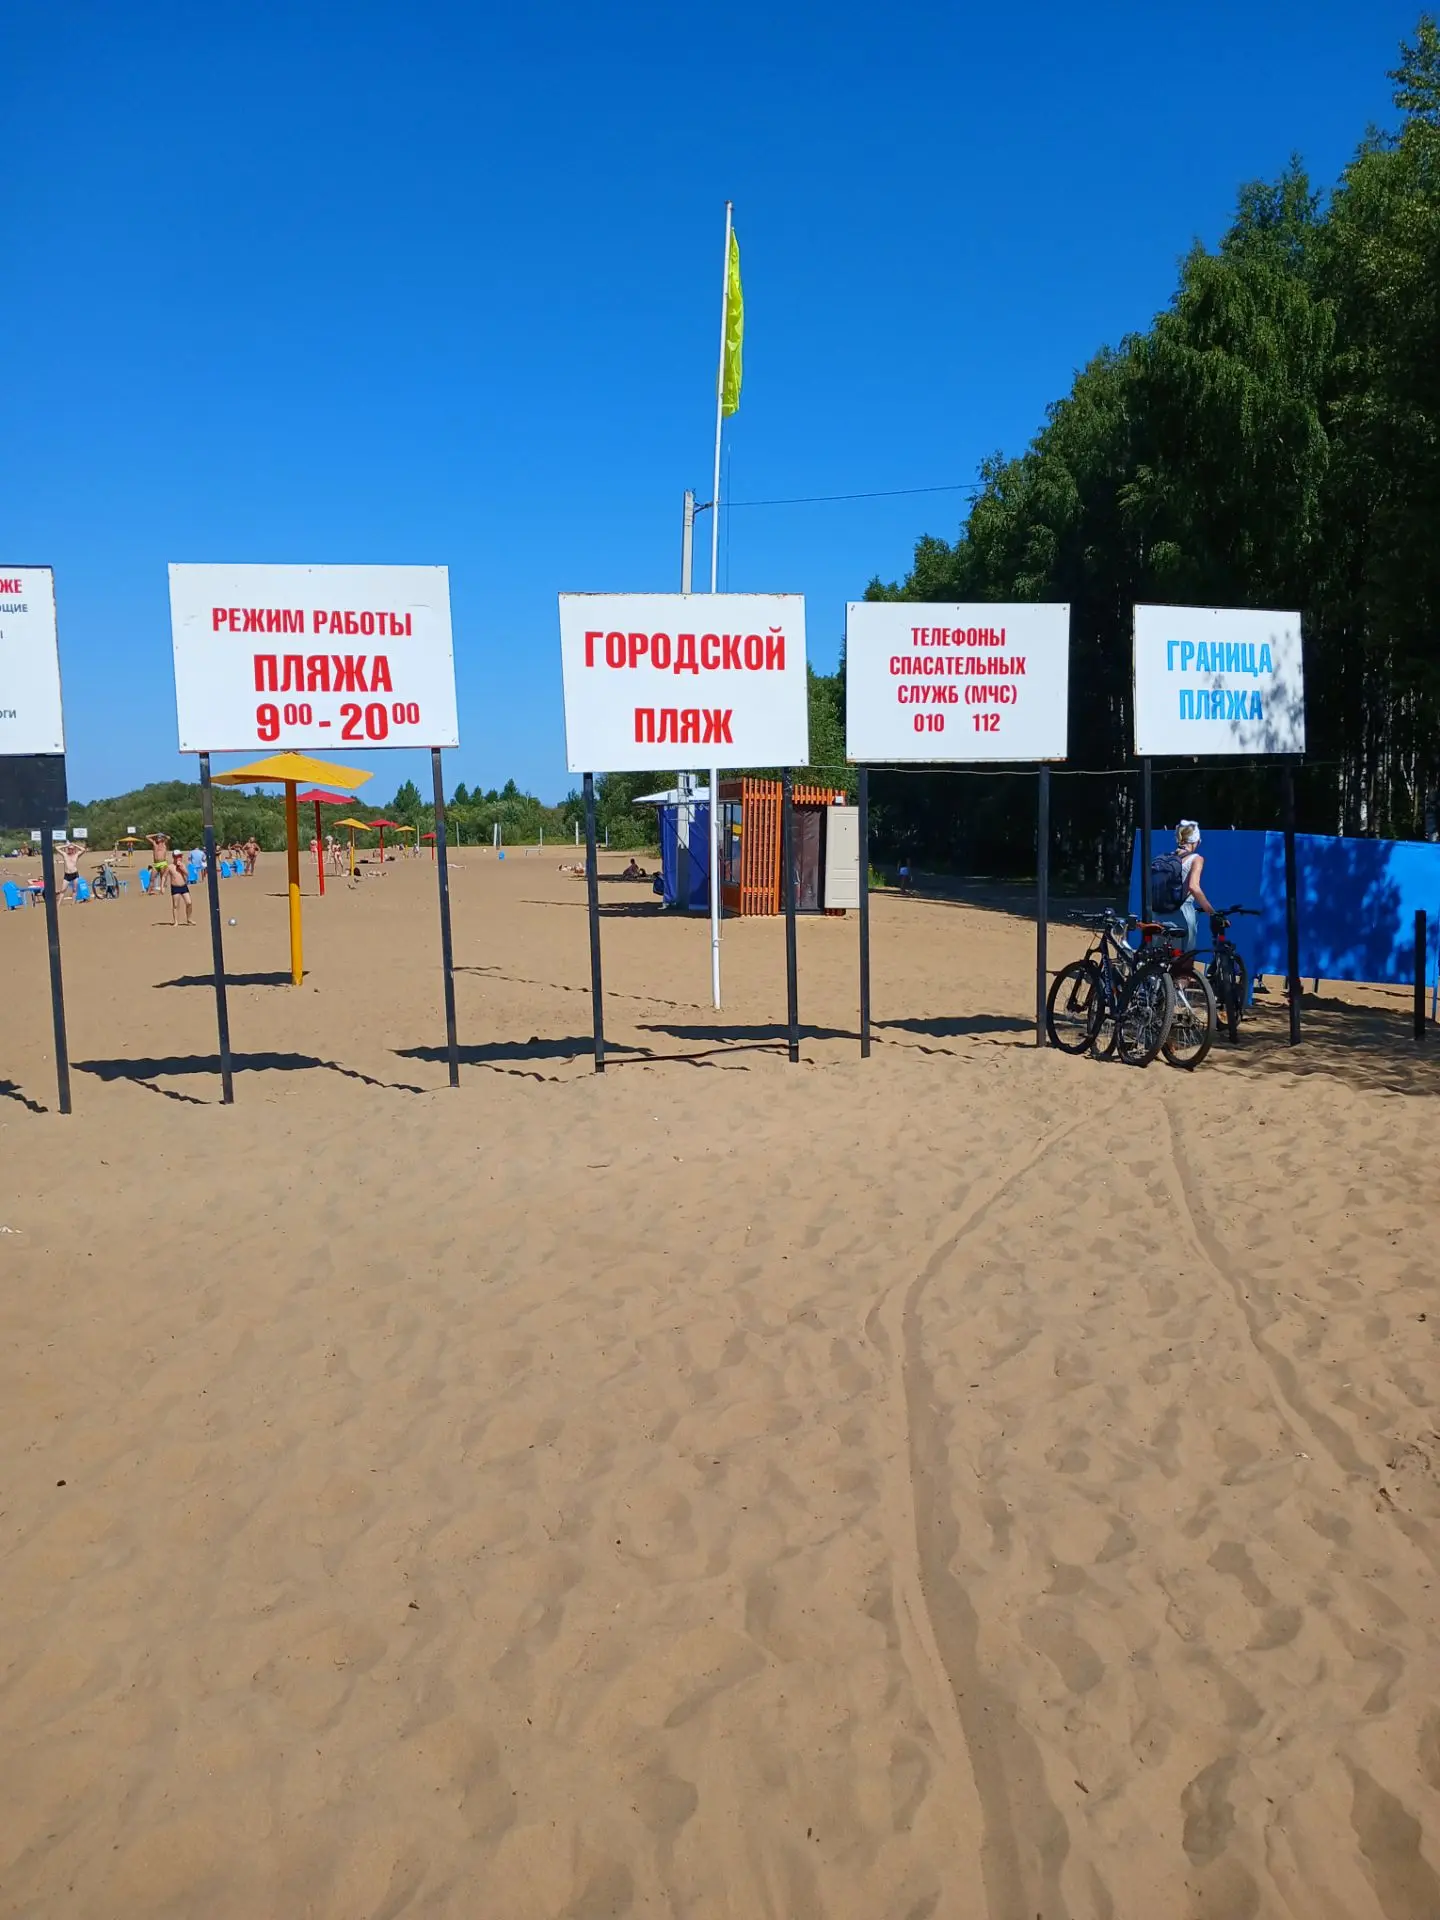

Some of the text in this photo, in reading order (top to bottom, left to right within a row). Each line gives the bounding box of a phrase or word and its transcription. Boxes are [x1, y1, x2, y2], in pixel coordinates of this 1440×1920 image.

[0, 604, 28, 614] ЩИЕ
[213, 608, 412, 637] РЕЖИМ РАБОТЫ
[584, 626, 785, 674] ГОРОДСКОЙ
[911, 628, 1005, 647] ТЕЛЕФОНЫ
[890, 656, 1026, 676] СПАСАТЕЛЬНЫХ
[1166, 640, 1273, 677] ГРАНИЦА
[254, 655, 393, 692] ПЛЯЖА
[898, 685, 1018, 705] СЛУЖБ (МЧС)
[1179, 689, 1263, 721] ПЛЯЖА
[634, 707, 733, 744] ПЛЯЖ
[913, 713, 1000, 733] 010 112
